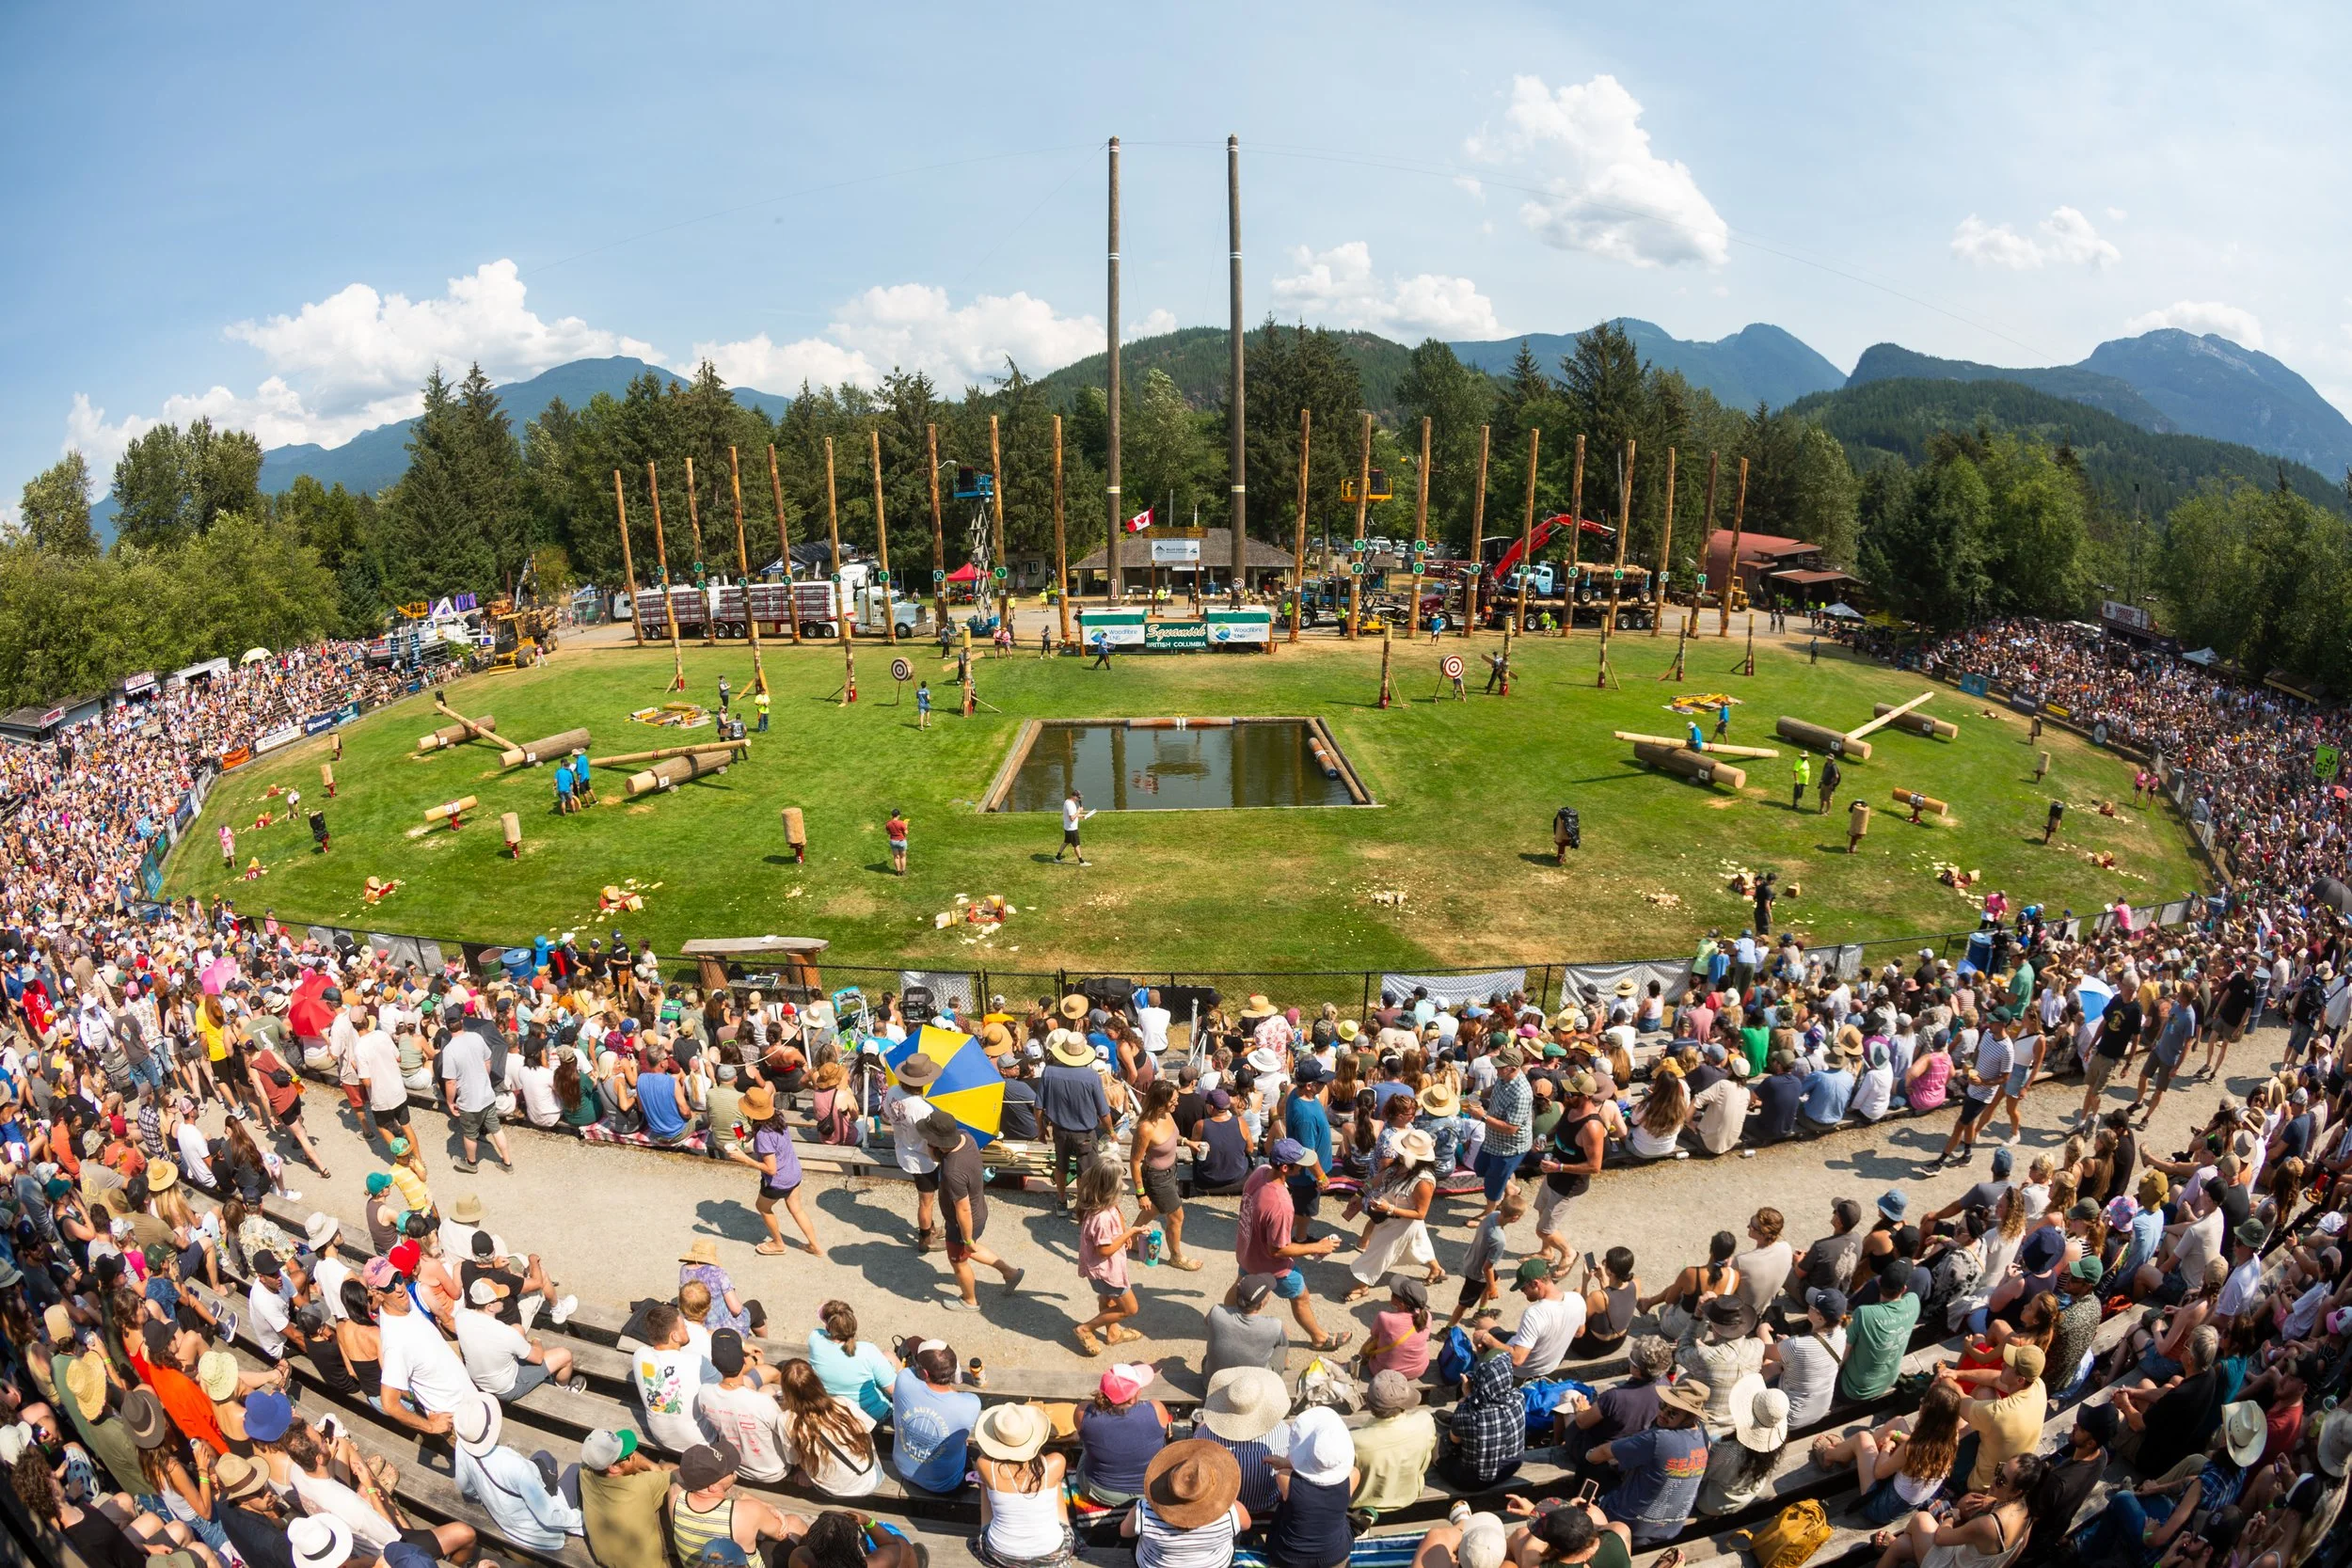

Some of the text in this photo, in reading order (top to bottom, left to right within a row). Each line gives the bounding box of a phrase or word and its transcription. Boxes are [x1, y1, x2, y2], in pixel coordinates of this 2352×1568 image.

[1111, 579, 1118, 599] 1
[1146, 624, 1206, 642] Squamish
[248, 871, 257, 880] 10
